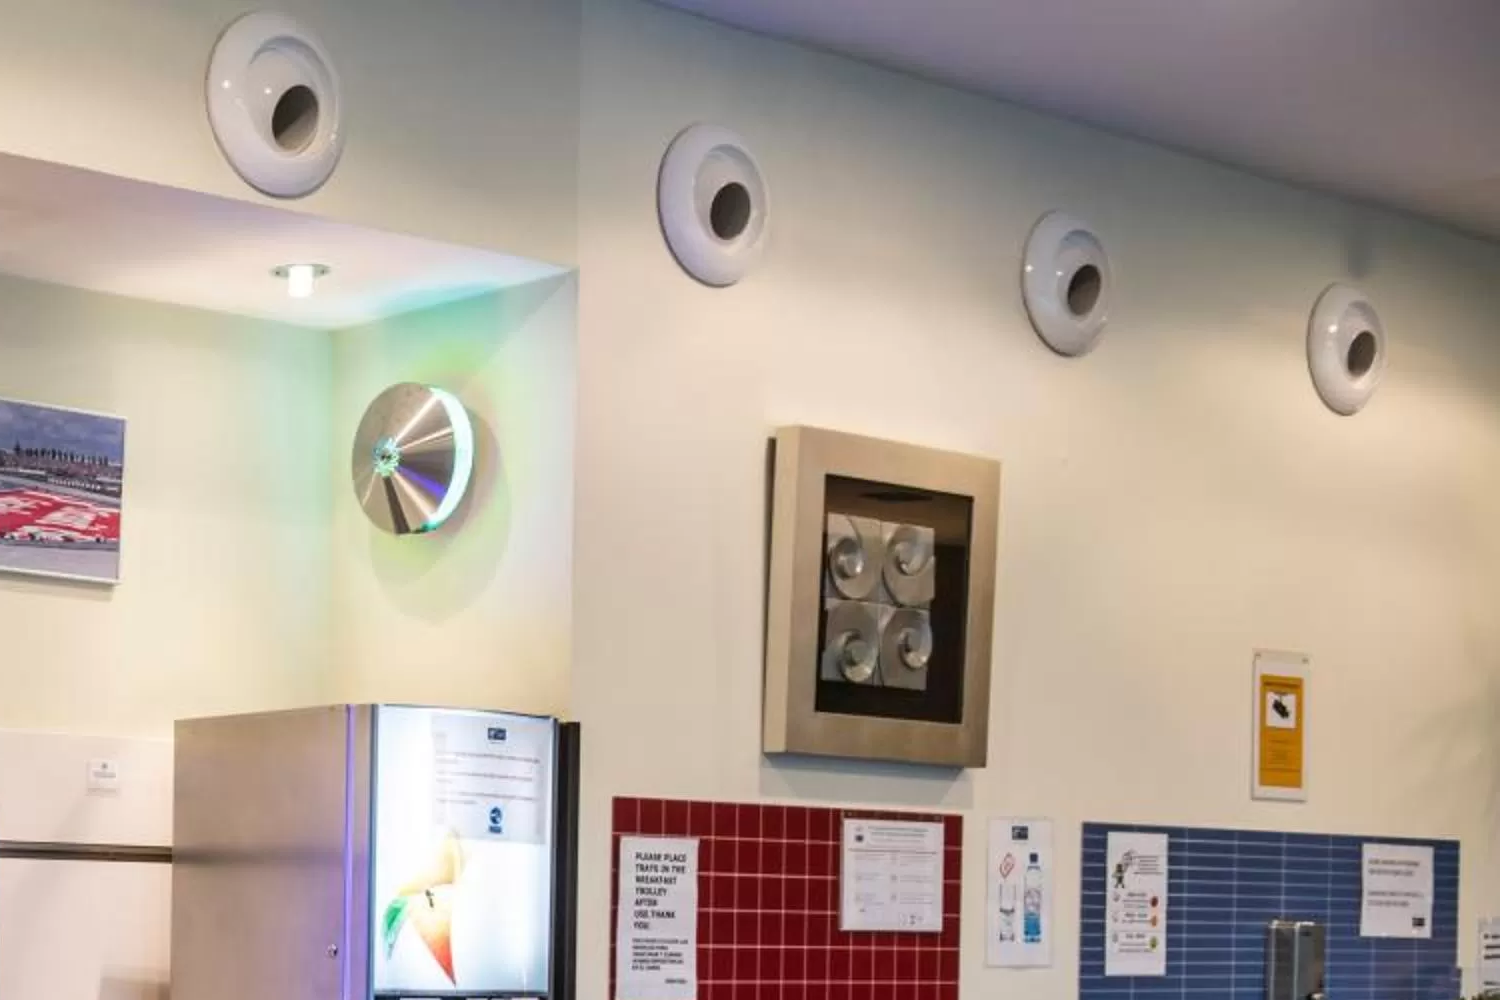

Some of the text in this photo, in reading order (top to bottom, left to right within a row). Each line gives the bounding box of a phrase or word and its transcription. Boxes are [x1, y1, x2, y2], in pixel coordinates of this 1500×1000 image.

[635, 852, 687, 863] PLEASE PLACE
[635, 863, 685, 874] TRAYS IN THE
[635, 875, 677, 885] BREAKFAST
[635, 887, 668, 896] TROLLEY
[635, 898, 658, 907] AFTER
[651, 910, 676, 919] THANK
